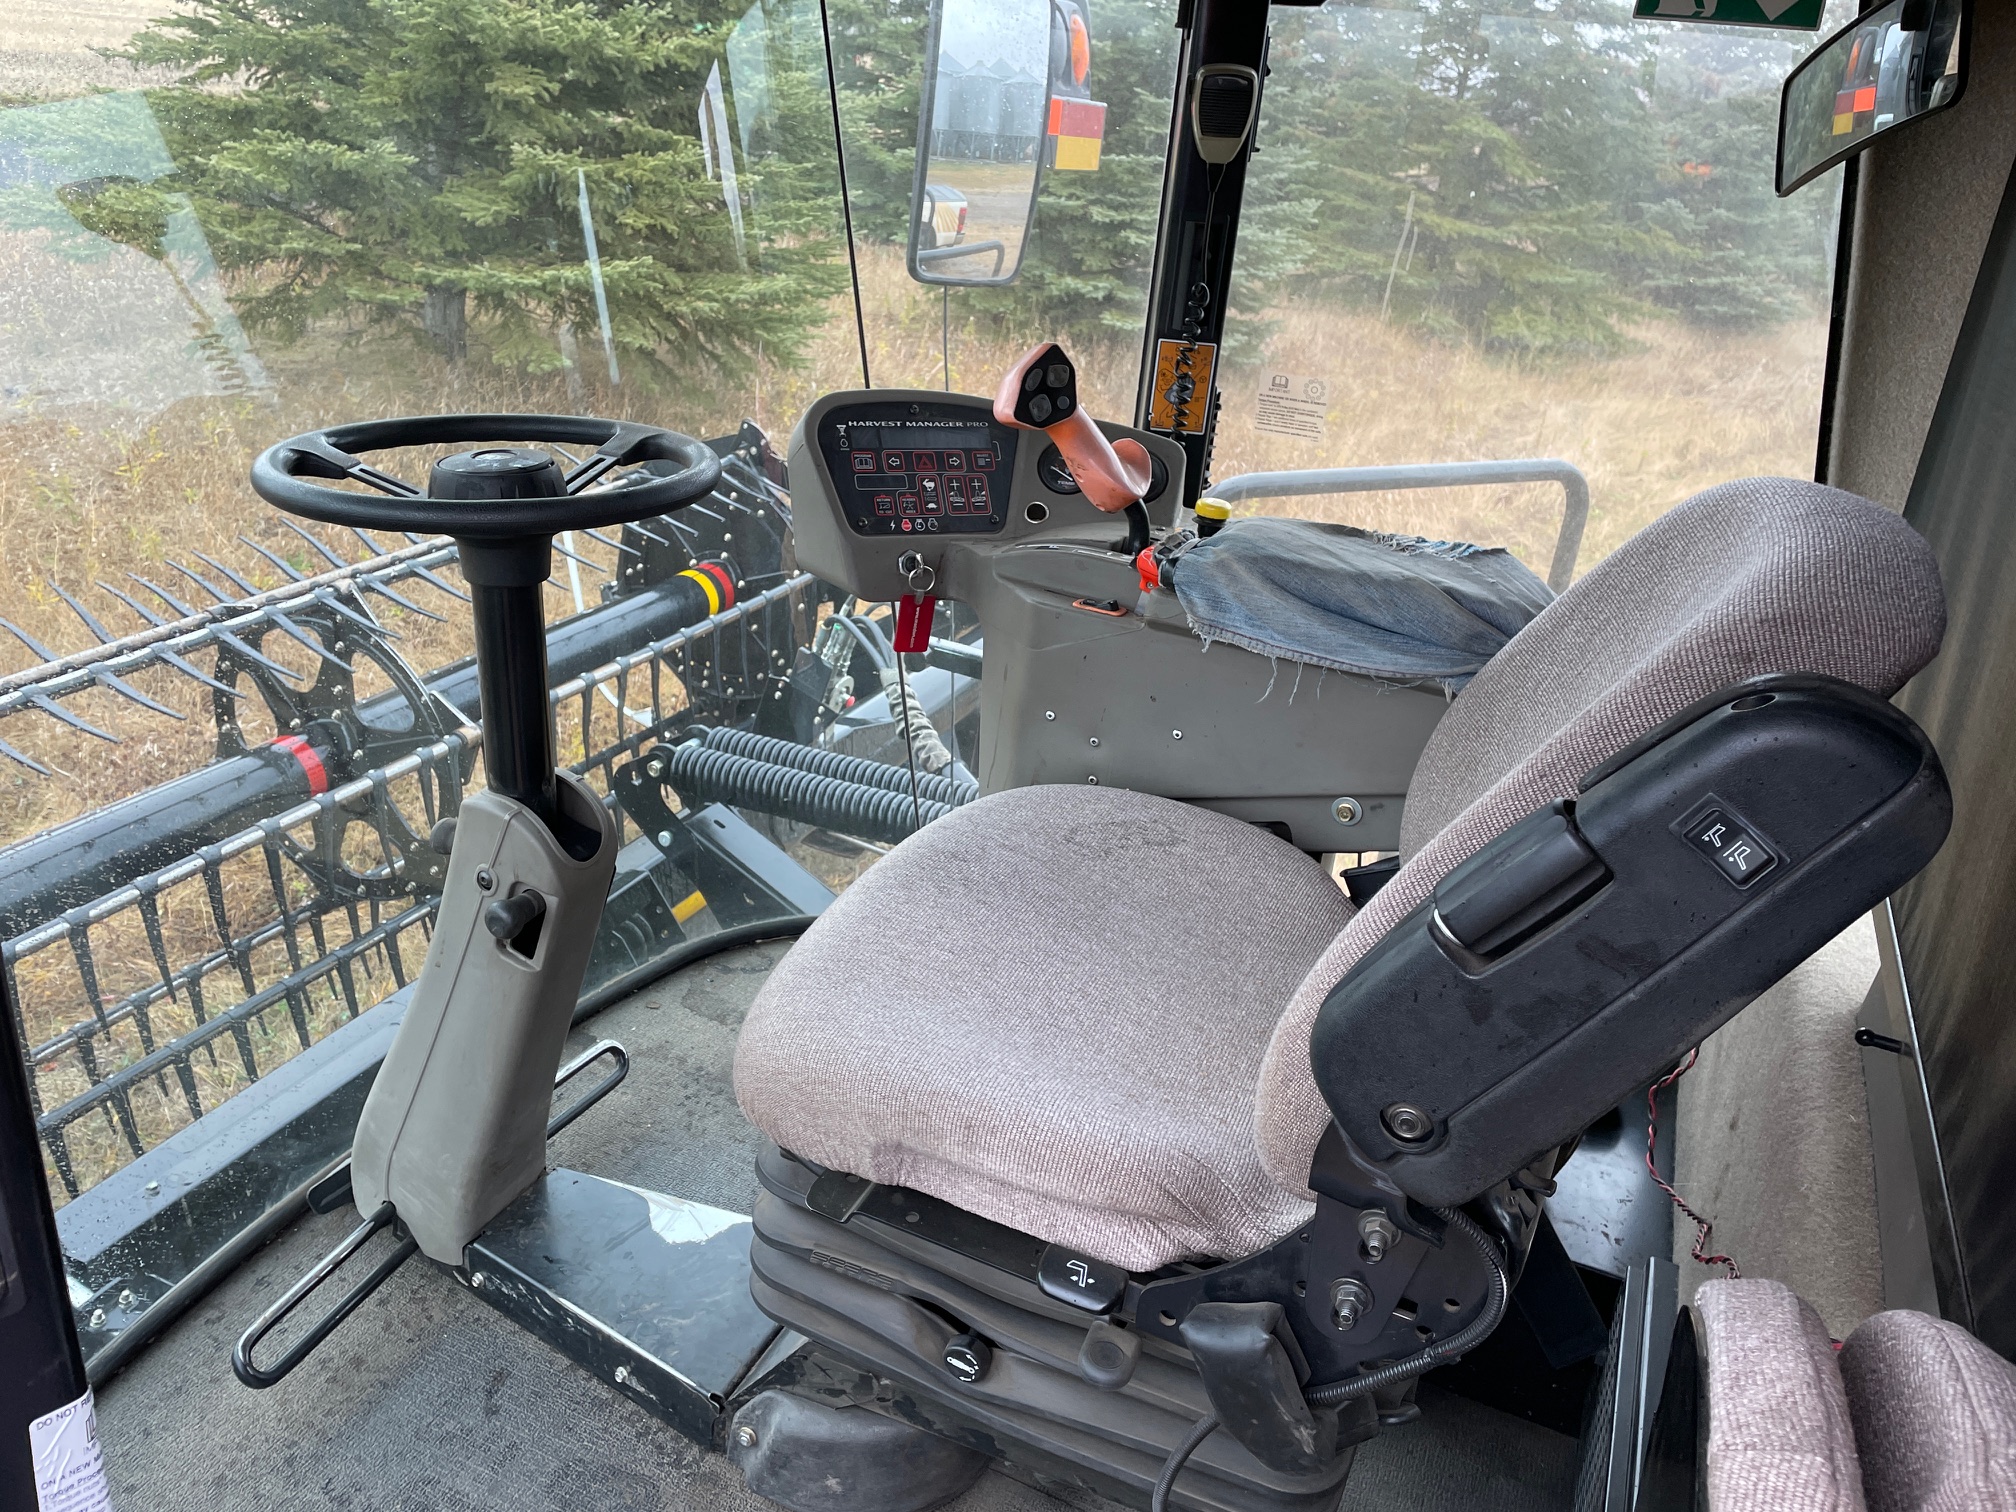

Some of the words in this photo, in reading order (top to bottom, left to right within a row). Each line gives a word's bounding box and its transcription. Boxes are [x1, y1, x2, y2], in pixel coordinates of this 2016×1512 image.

[848, 420, 903, 428] HARVEST
[905, 420, 964, 428] MANAGER
[36, 1417, 53, 1431] DO
[56, 1404, 78, 1422] NOT
[41, 1478, 56, 1491] ON
[69, 1460, 91, 1477] NEW
[42, 1484, 75, 1503] Torque
